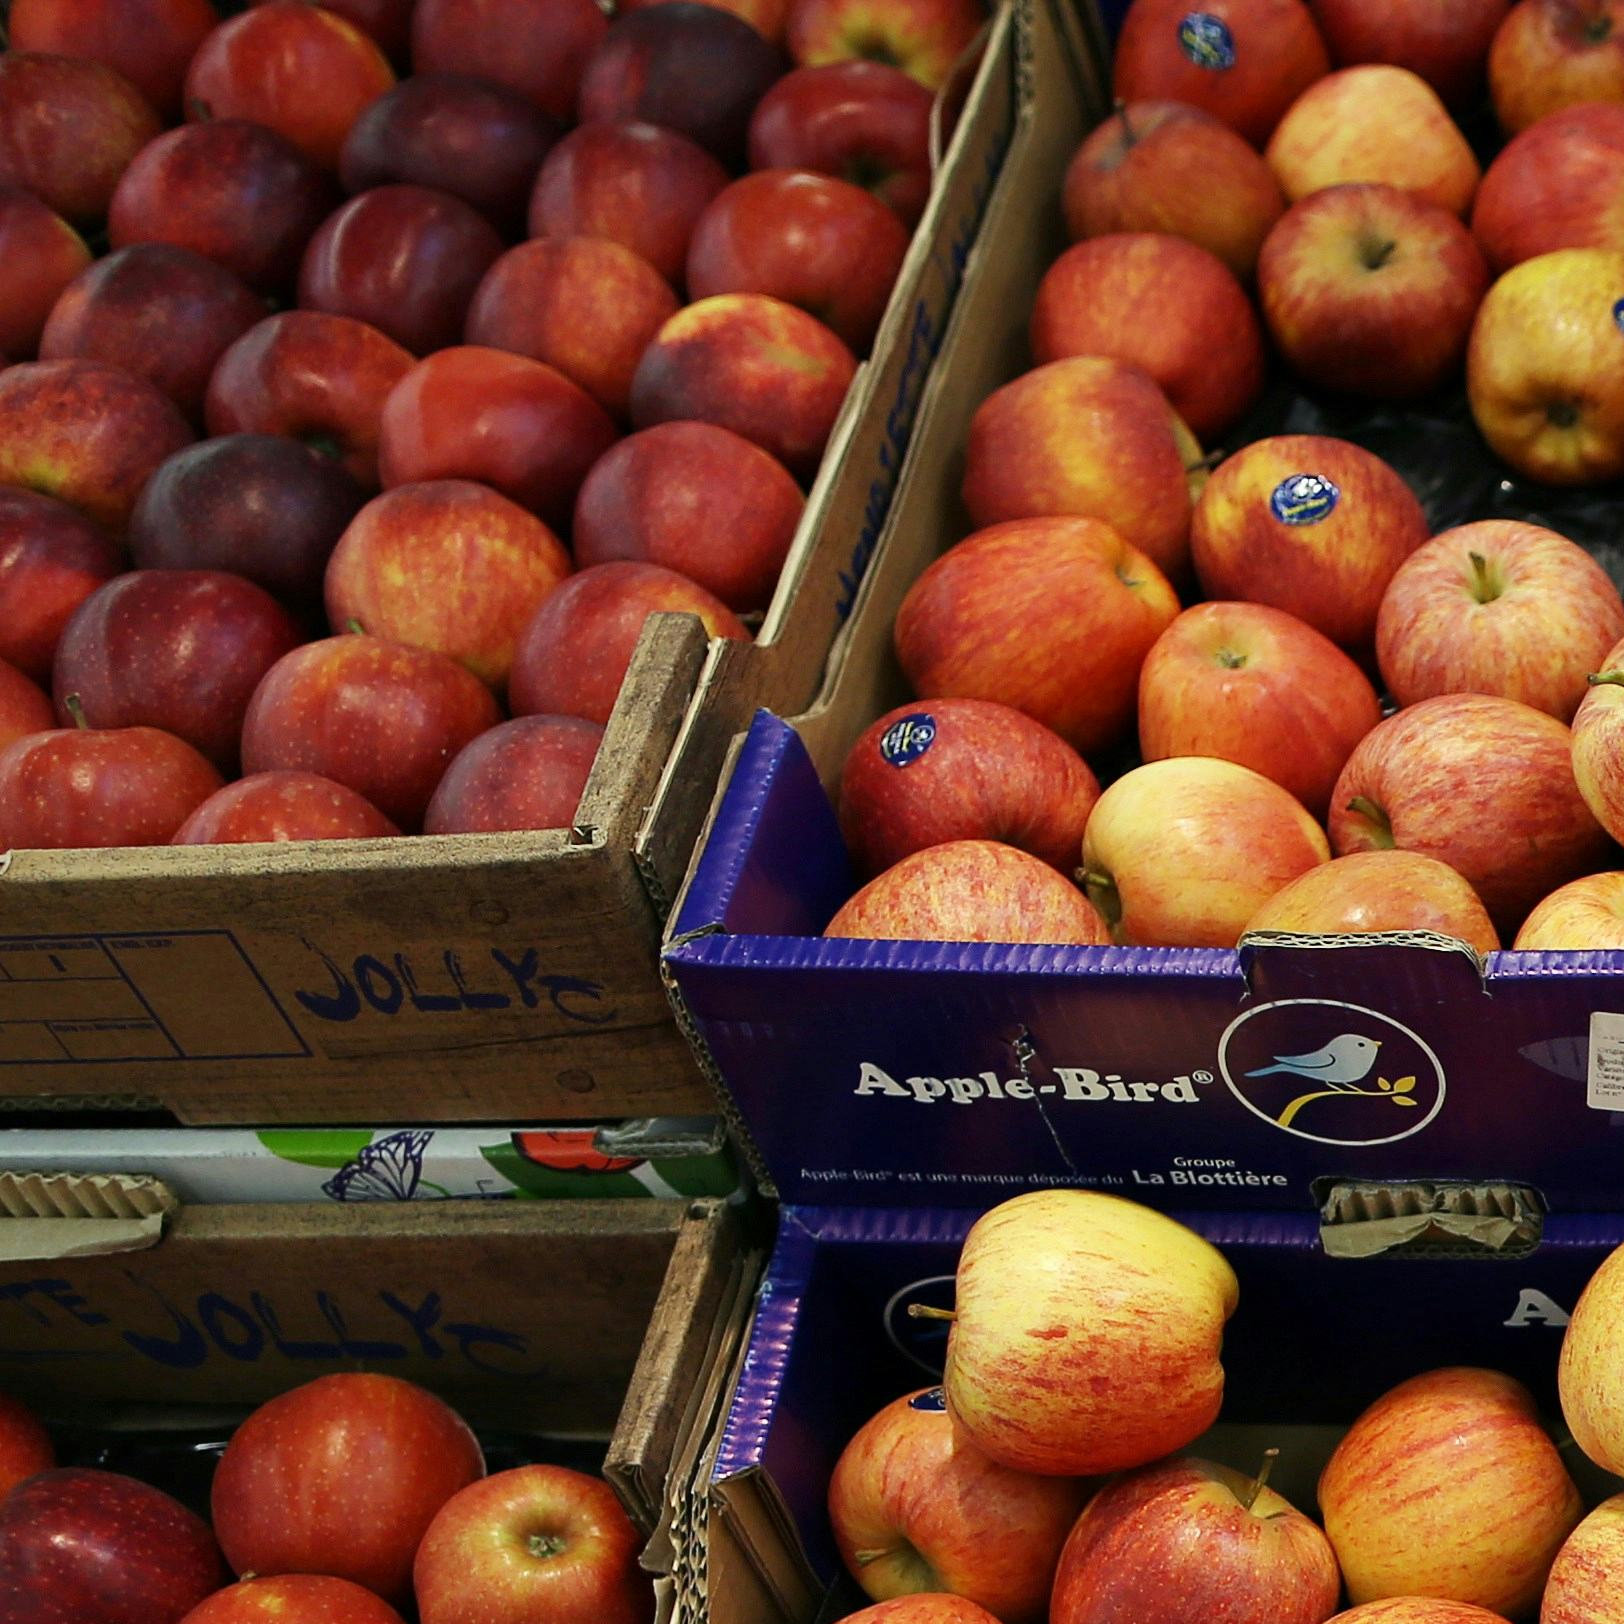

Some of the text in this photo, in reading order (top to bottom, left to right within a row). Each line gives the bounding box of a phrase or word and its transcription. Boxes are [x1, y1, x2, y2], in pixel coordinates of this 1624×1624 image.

[295, 937, 538, 1021] JOLLY
[1174, 1156, 1235, 1169] Groupe
[899, 1173, 922, 1182] est
[927, 1174, 957, 1183] une
[961, 1174, 1024, 1186] marque
[1029, 1172, 1098, 1187] déposée
[1102, 1173, 1124, 1185] du
[1132, 1168, 1288, 1189] La Blottière
[122, 1268, 445, 1368] JOLLY
